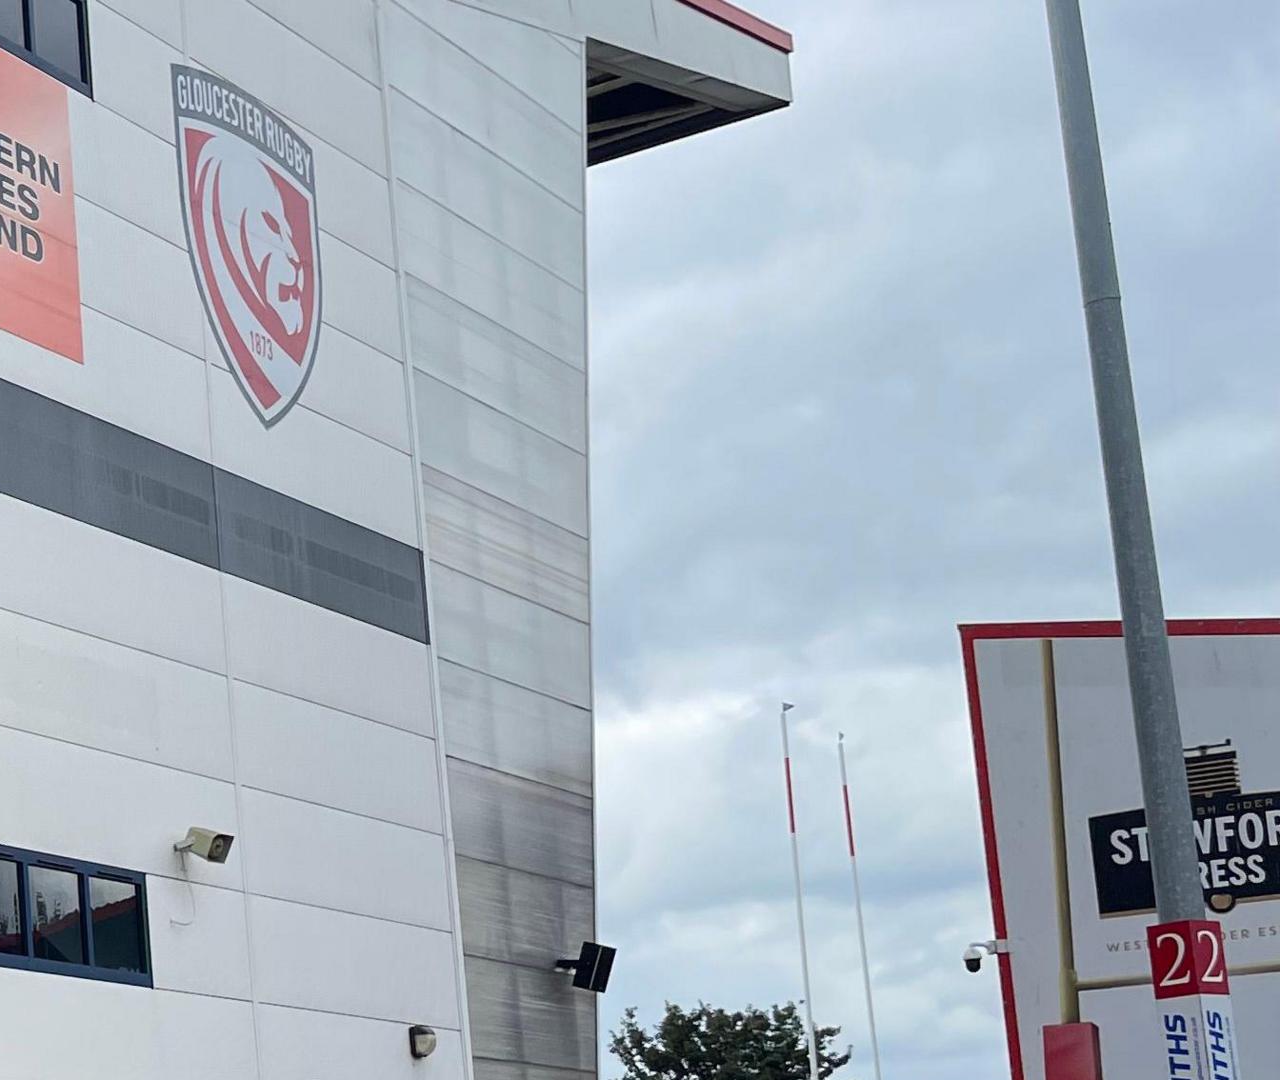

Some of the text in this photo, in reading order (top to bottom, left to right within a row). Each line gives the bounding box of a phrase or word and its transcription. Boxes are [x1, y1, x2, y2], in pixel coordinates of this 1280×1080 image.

[177, 75, 311, 184] GLOUCESTER RUGBY
[248, 330, 274, 361] 1873
[1226, 797, 1273, 811] CIDER
[1198, 854, 1266, 890] RESS
